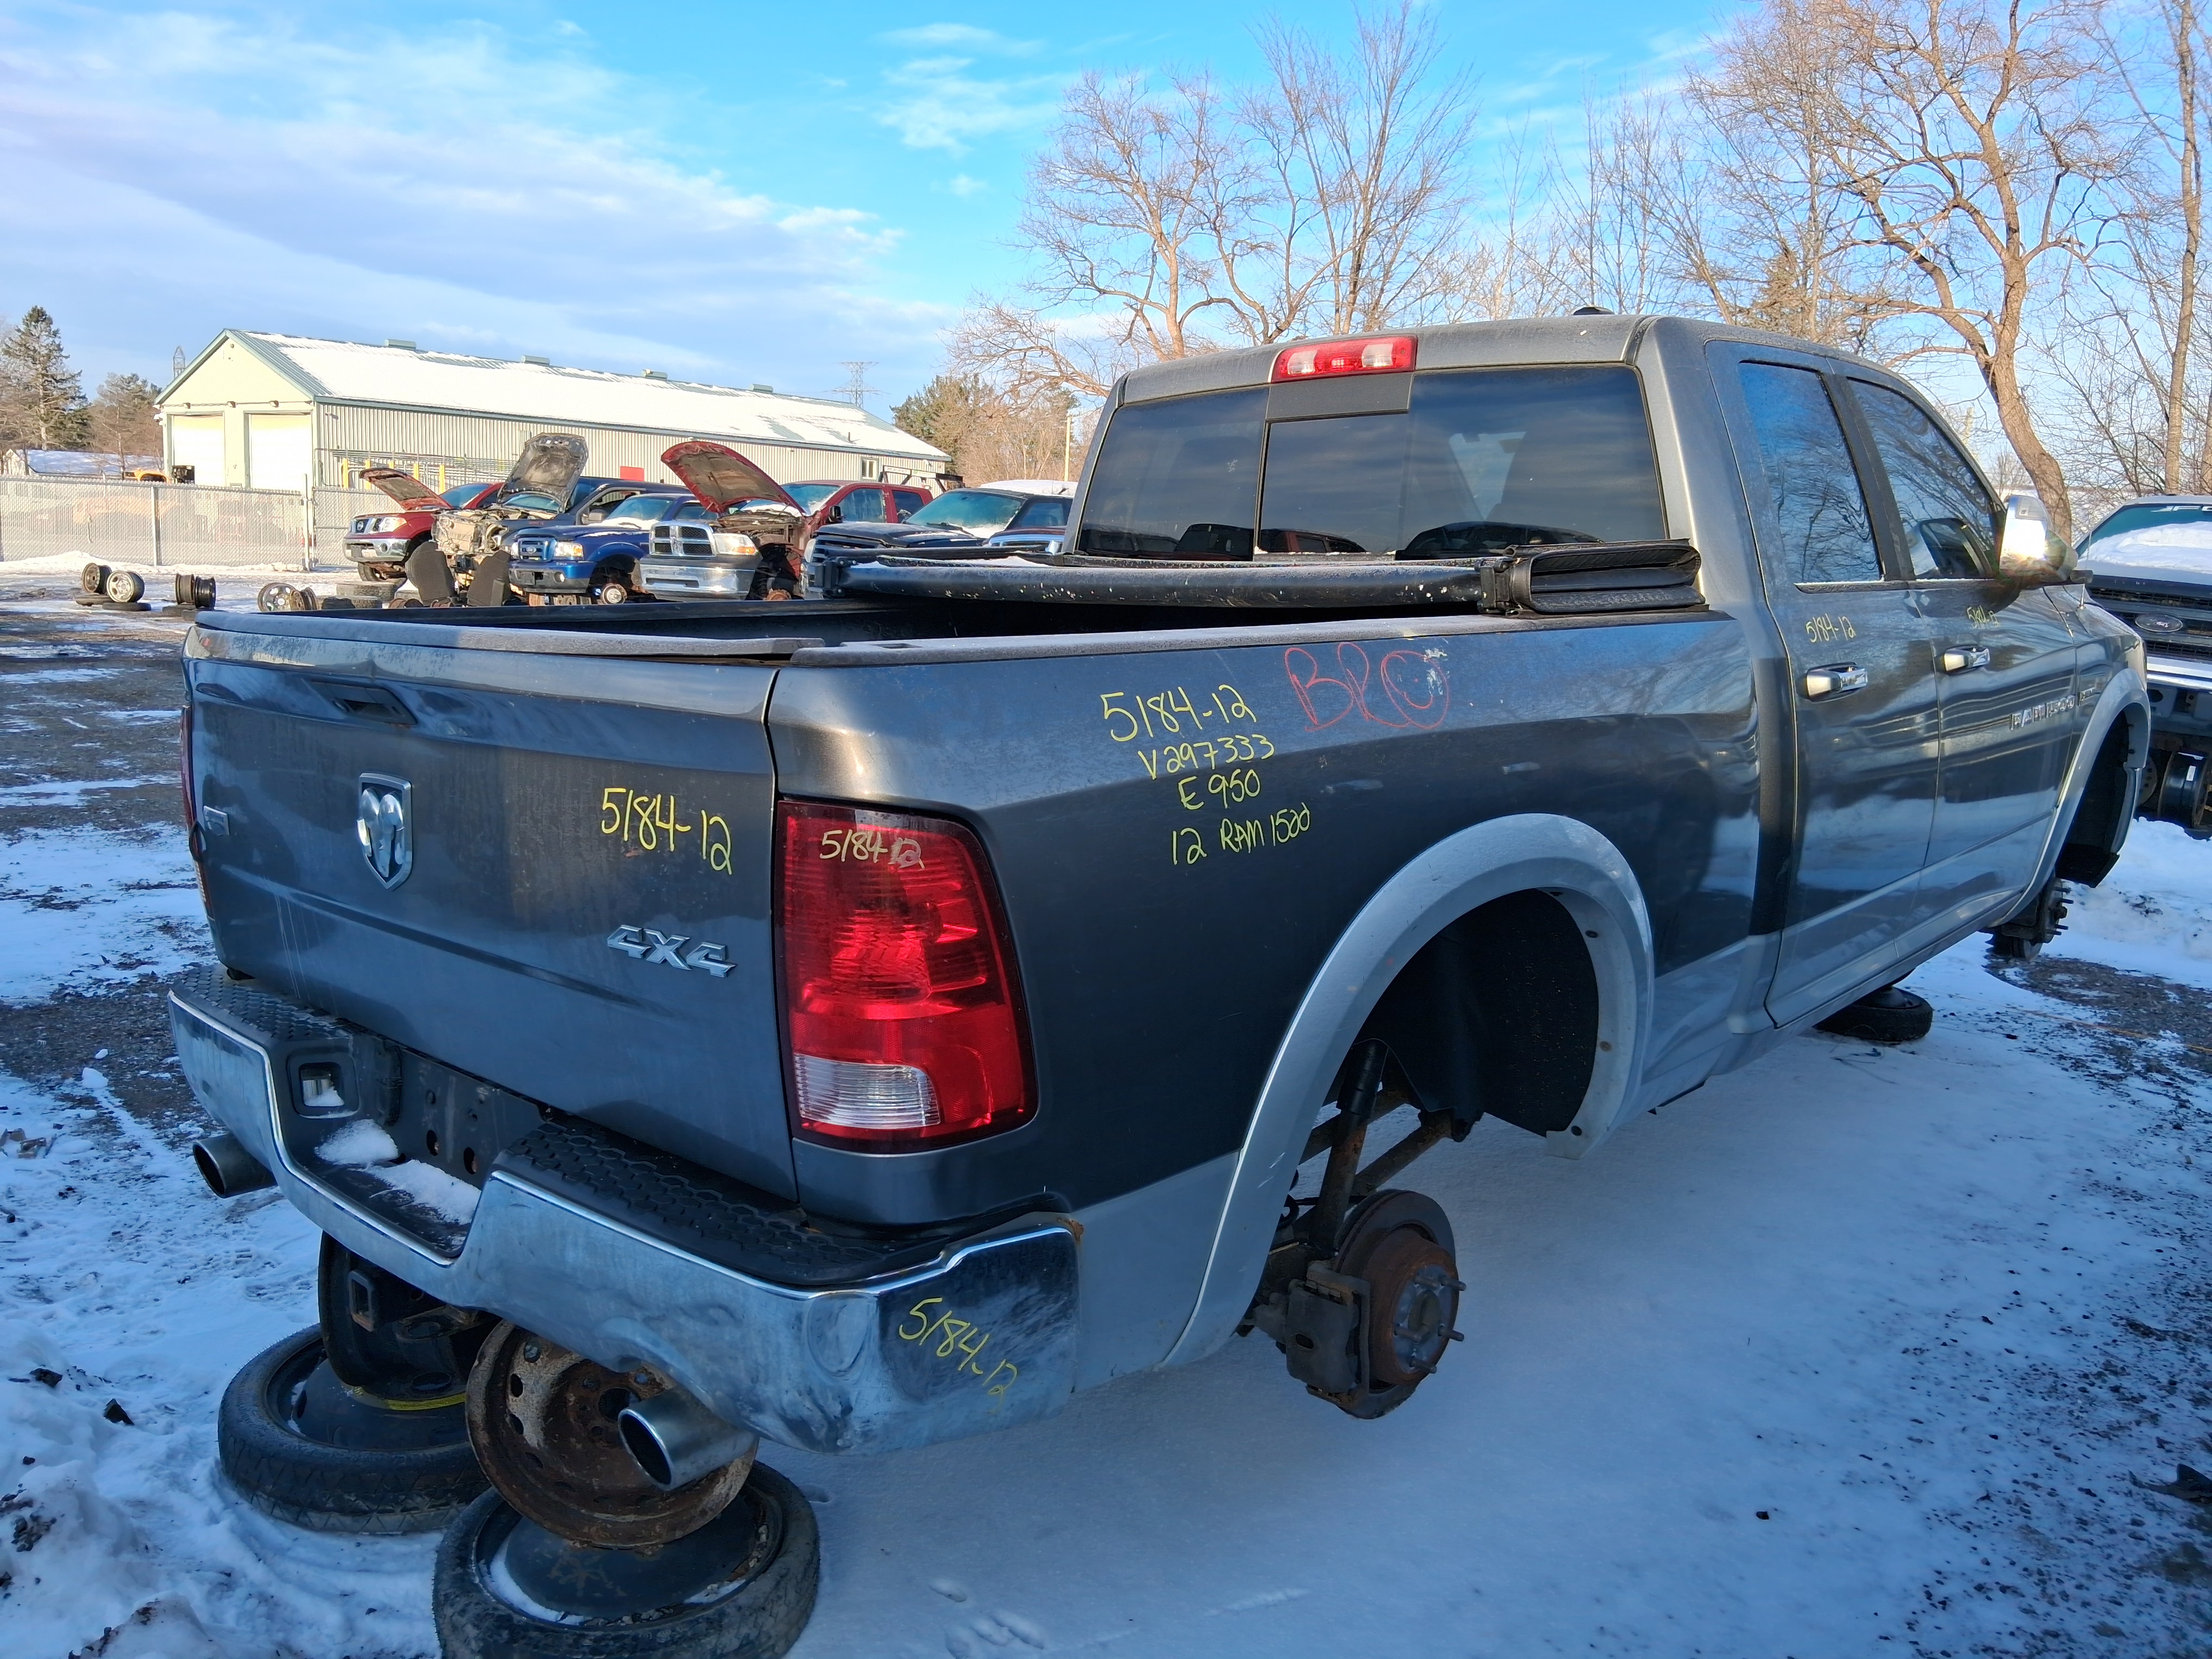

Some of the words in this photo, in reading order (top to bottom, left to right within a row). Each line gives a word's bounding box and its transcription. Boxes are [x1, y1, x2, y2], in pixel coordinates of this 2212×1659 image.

[1805, 613, 1856, 643] 5184-12
[1099, 684, 1257, 742] 5184-12
[1178, 775, 1205, 810] E
[1207, 768, 1261, 809] 950
[600, 787, 733, 875] 5184-12
[1172, 827, 1207, 865] 12
[1220, 818, 1265, 854] RAM
[898, 1297, 1018, 1415] 5184-12
